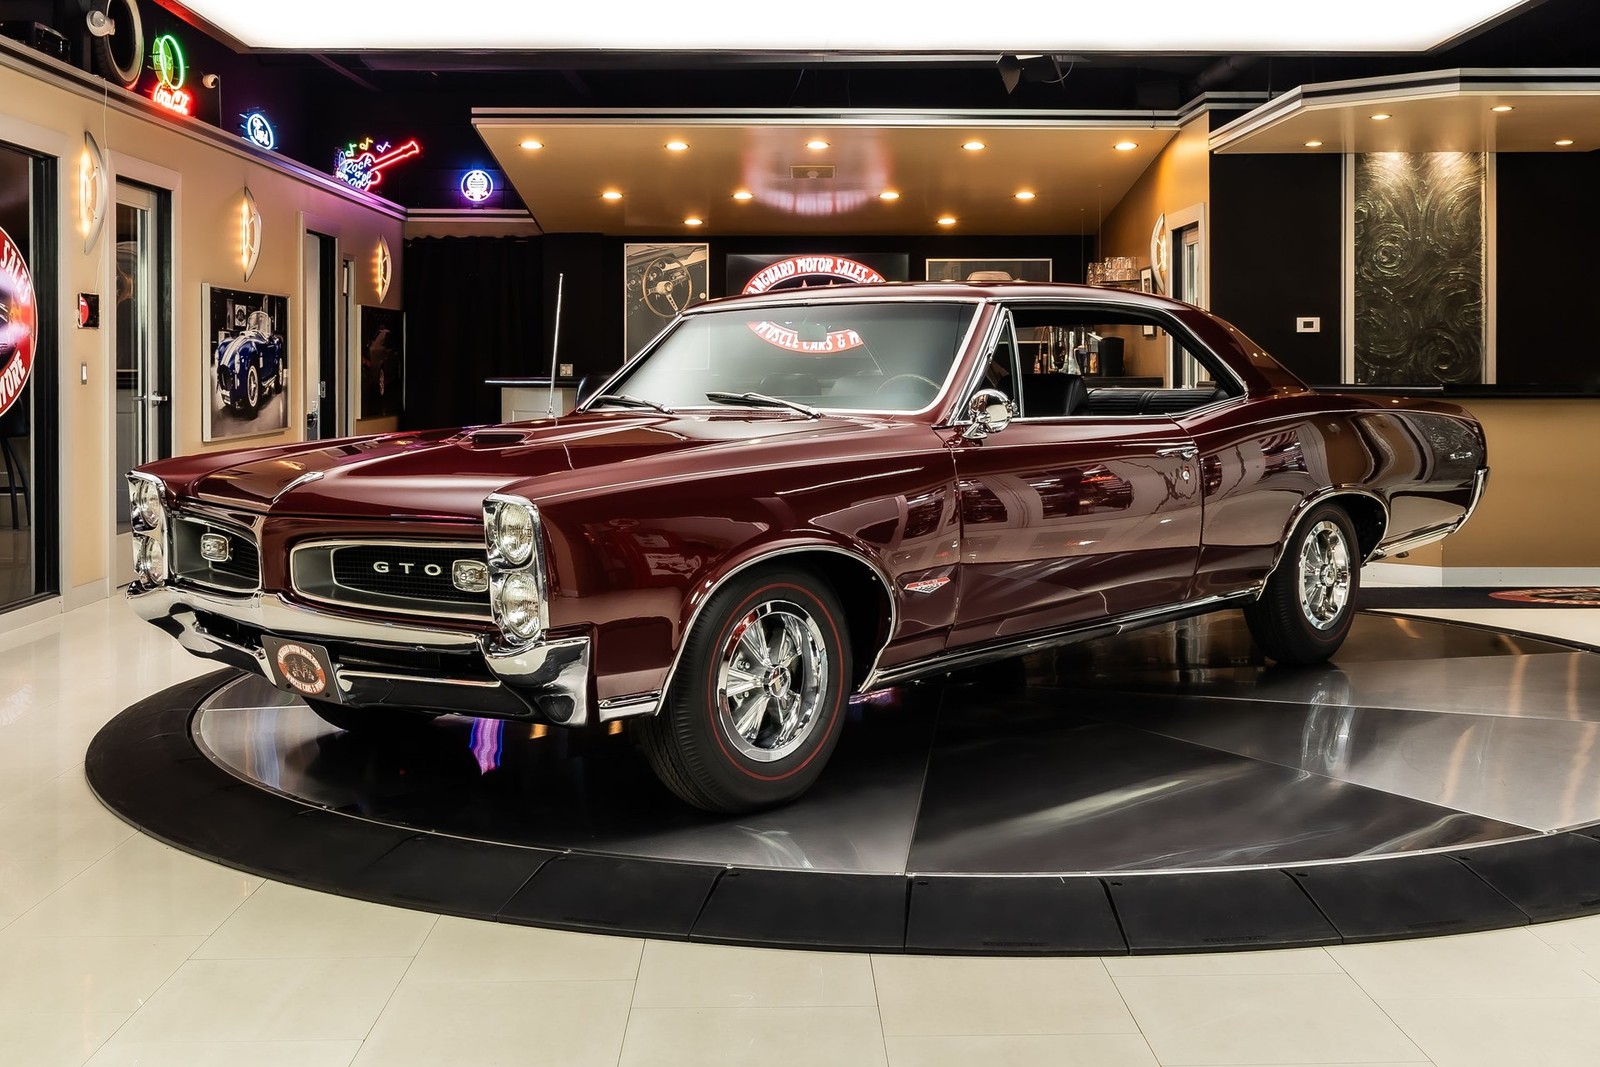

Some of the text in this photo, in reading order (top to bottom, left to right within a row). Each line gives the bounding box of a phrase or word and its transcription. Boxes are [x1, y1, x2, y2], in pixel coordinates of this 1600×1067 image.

[345, 154, 372, 174] Rock
[0, 239, 31, 304] SALES
[745, 260, 796, 294] ANGUARD
[795, 257, 834, 274] MOTOR
[755, 321, 799, 349] MUSCLE
[836, 333, 847, 349] &
[373, 561, 442, 576] GTO
